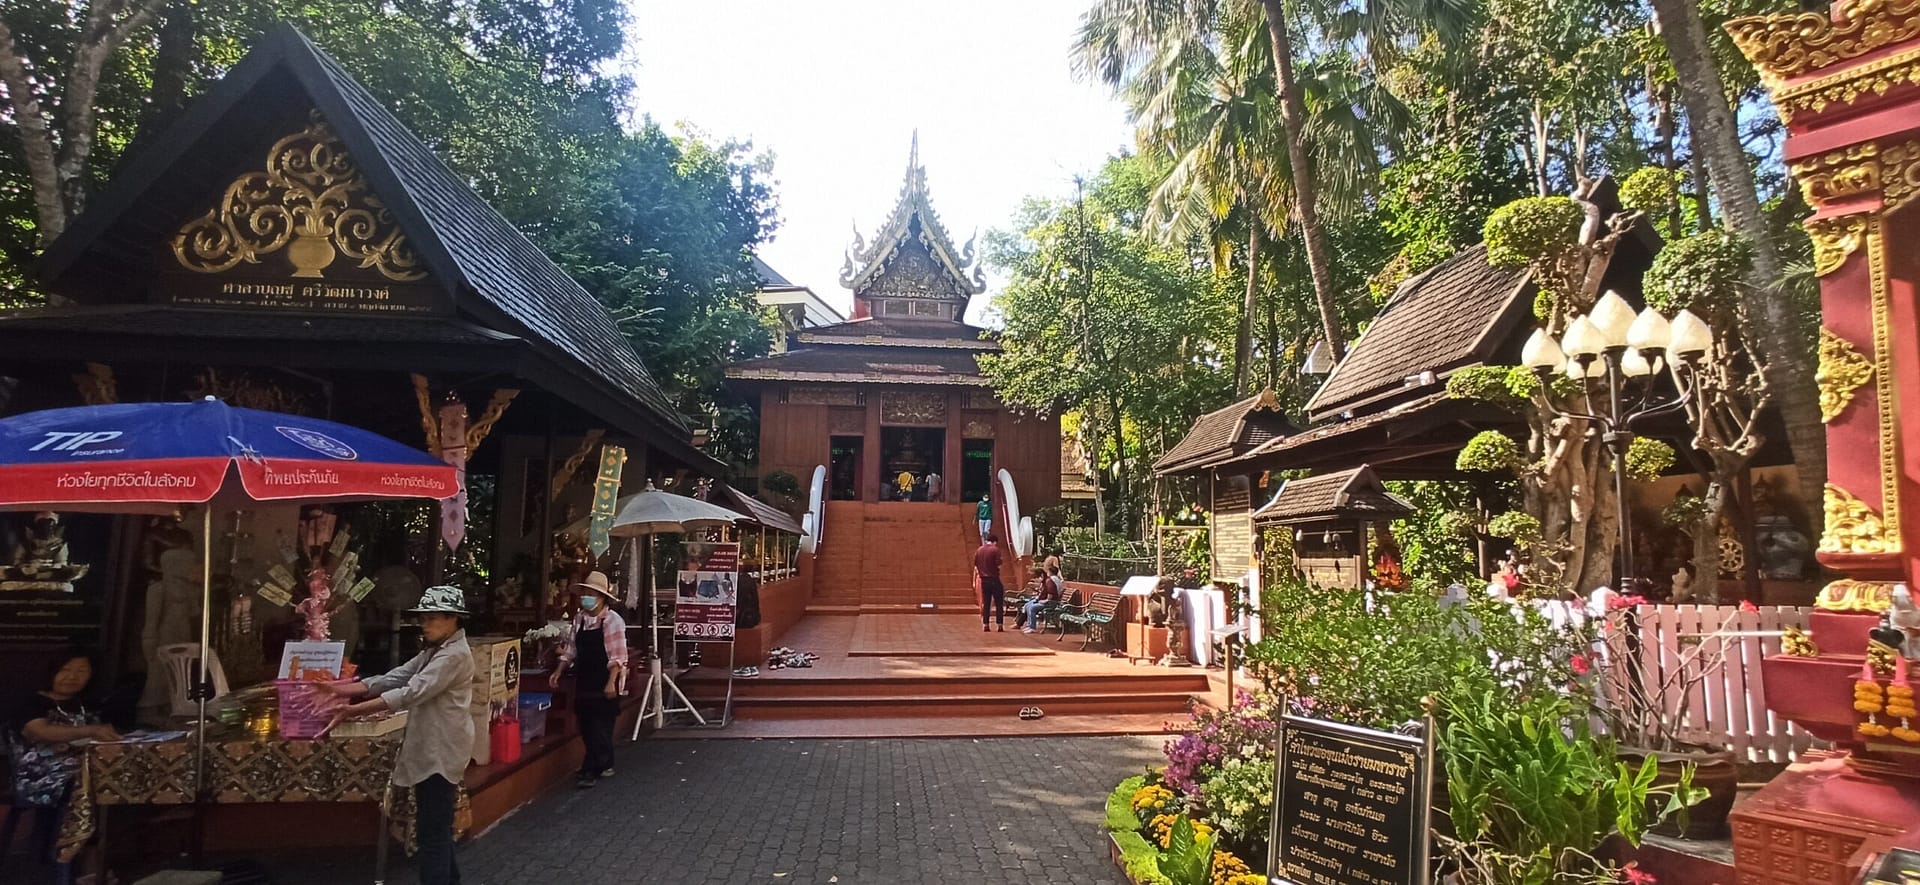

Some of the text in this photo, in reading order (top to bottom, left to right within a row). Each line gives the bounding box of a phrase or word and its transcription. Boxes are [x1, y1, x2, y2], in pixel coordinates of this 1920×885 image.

[28, 431, 123, 451] TIP
[57, 471, 197, 490] ห่วงใยทุกชีวิตในสังคม
[263, 467, 339, 485] ทิพยประกันภัย
